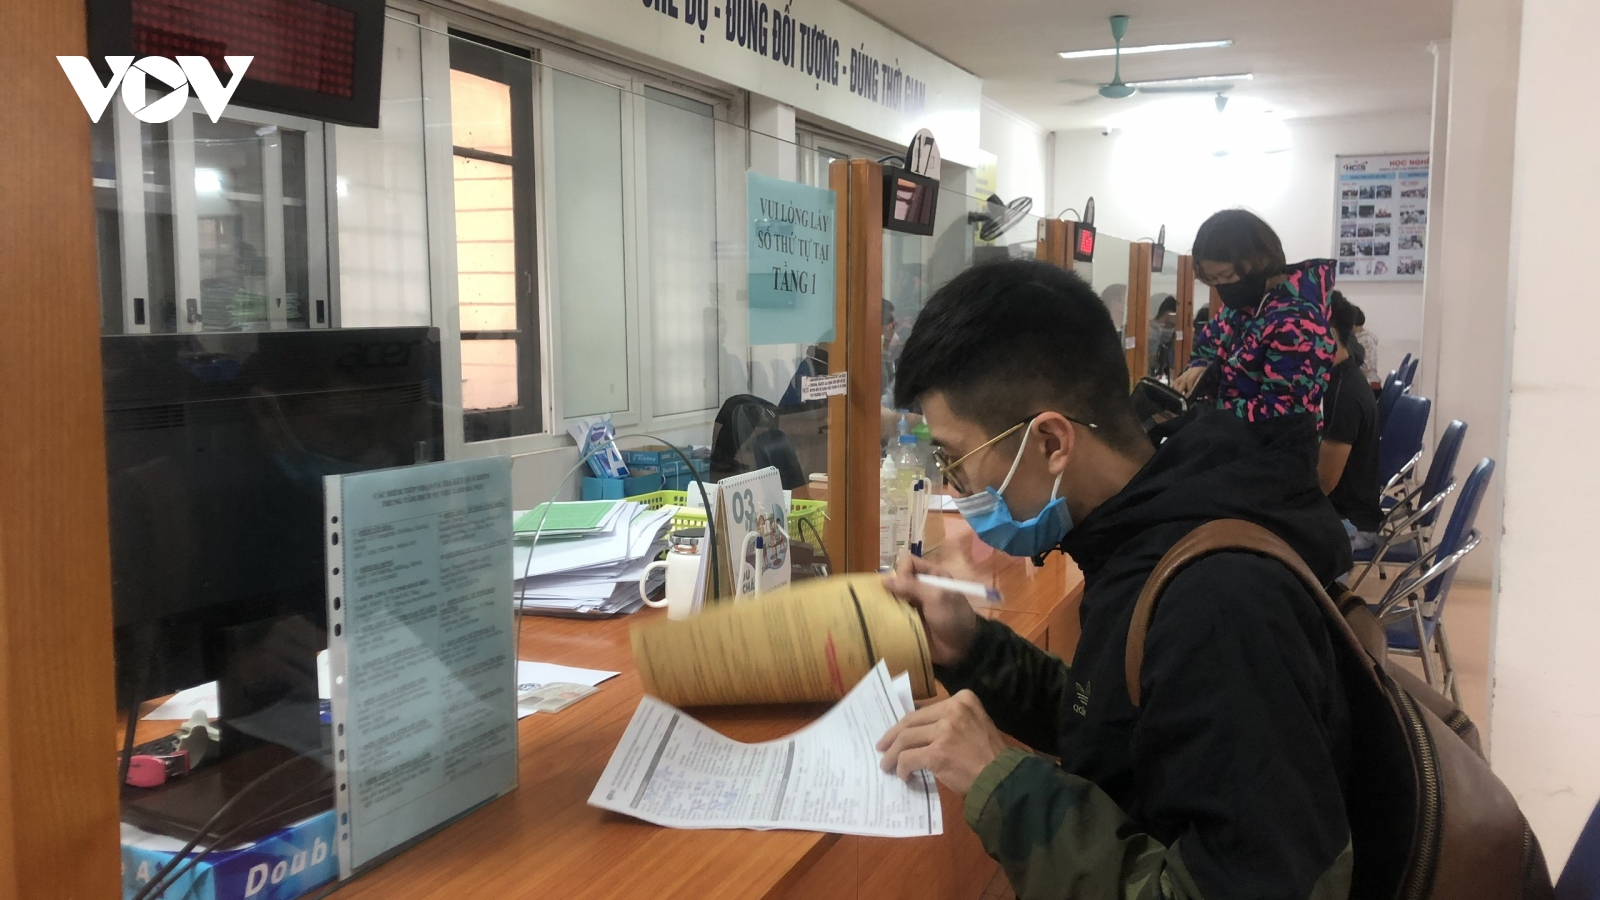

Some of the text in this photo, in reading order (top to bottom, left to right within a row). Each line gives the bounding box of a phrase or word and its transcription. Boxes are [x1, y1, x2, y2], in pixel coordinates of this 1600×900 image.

[800, 22, 840, 90] TƯỢNG
[850, 43, 879, 103] ĐÚNG
[882, 58, 902, 112] THỜI
[915, 133, 934, 177] 17
[760, 197, 778, 220] VUI
[781, 200, 808, 227] LÒNG
[758, 226, 829, 265] SỐ THỨ TỰ TẠI
[772, 261, 816, 294] TẦNG 1
[732, 488, 755, 524] 03
